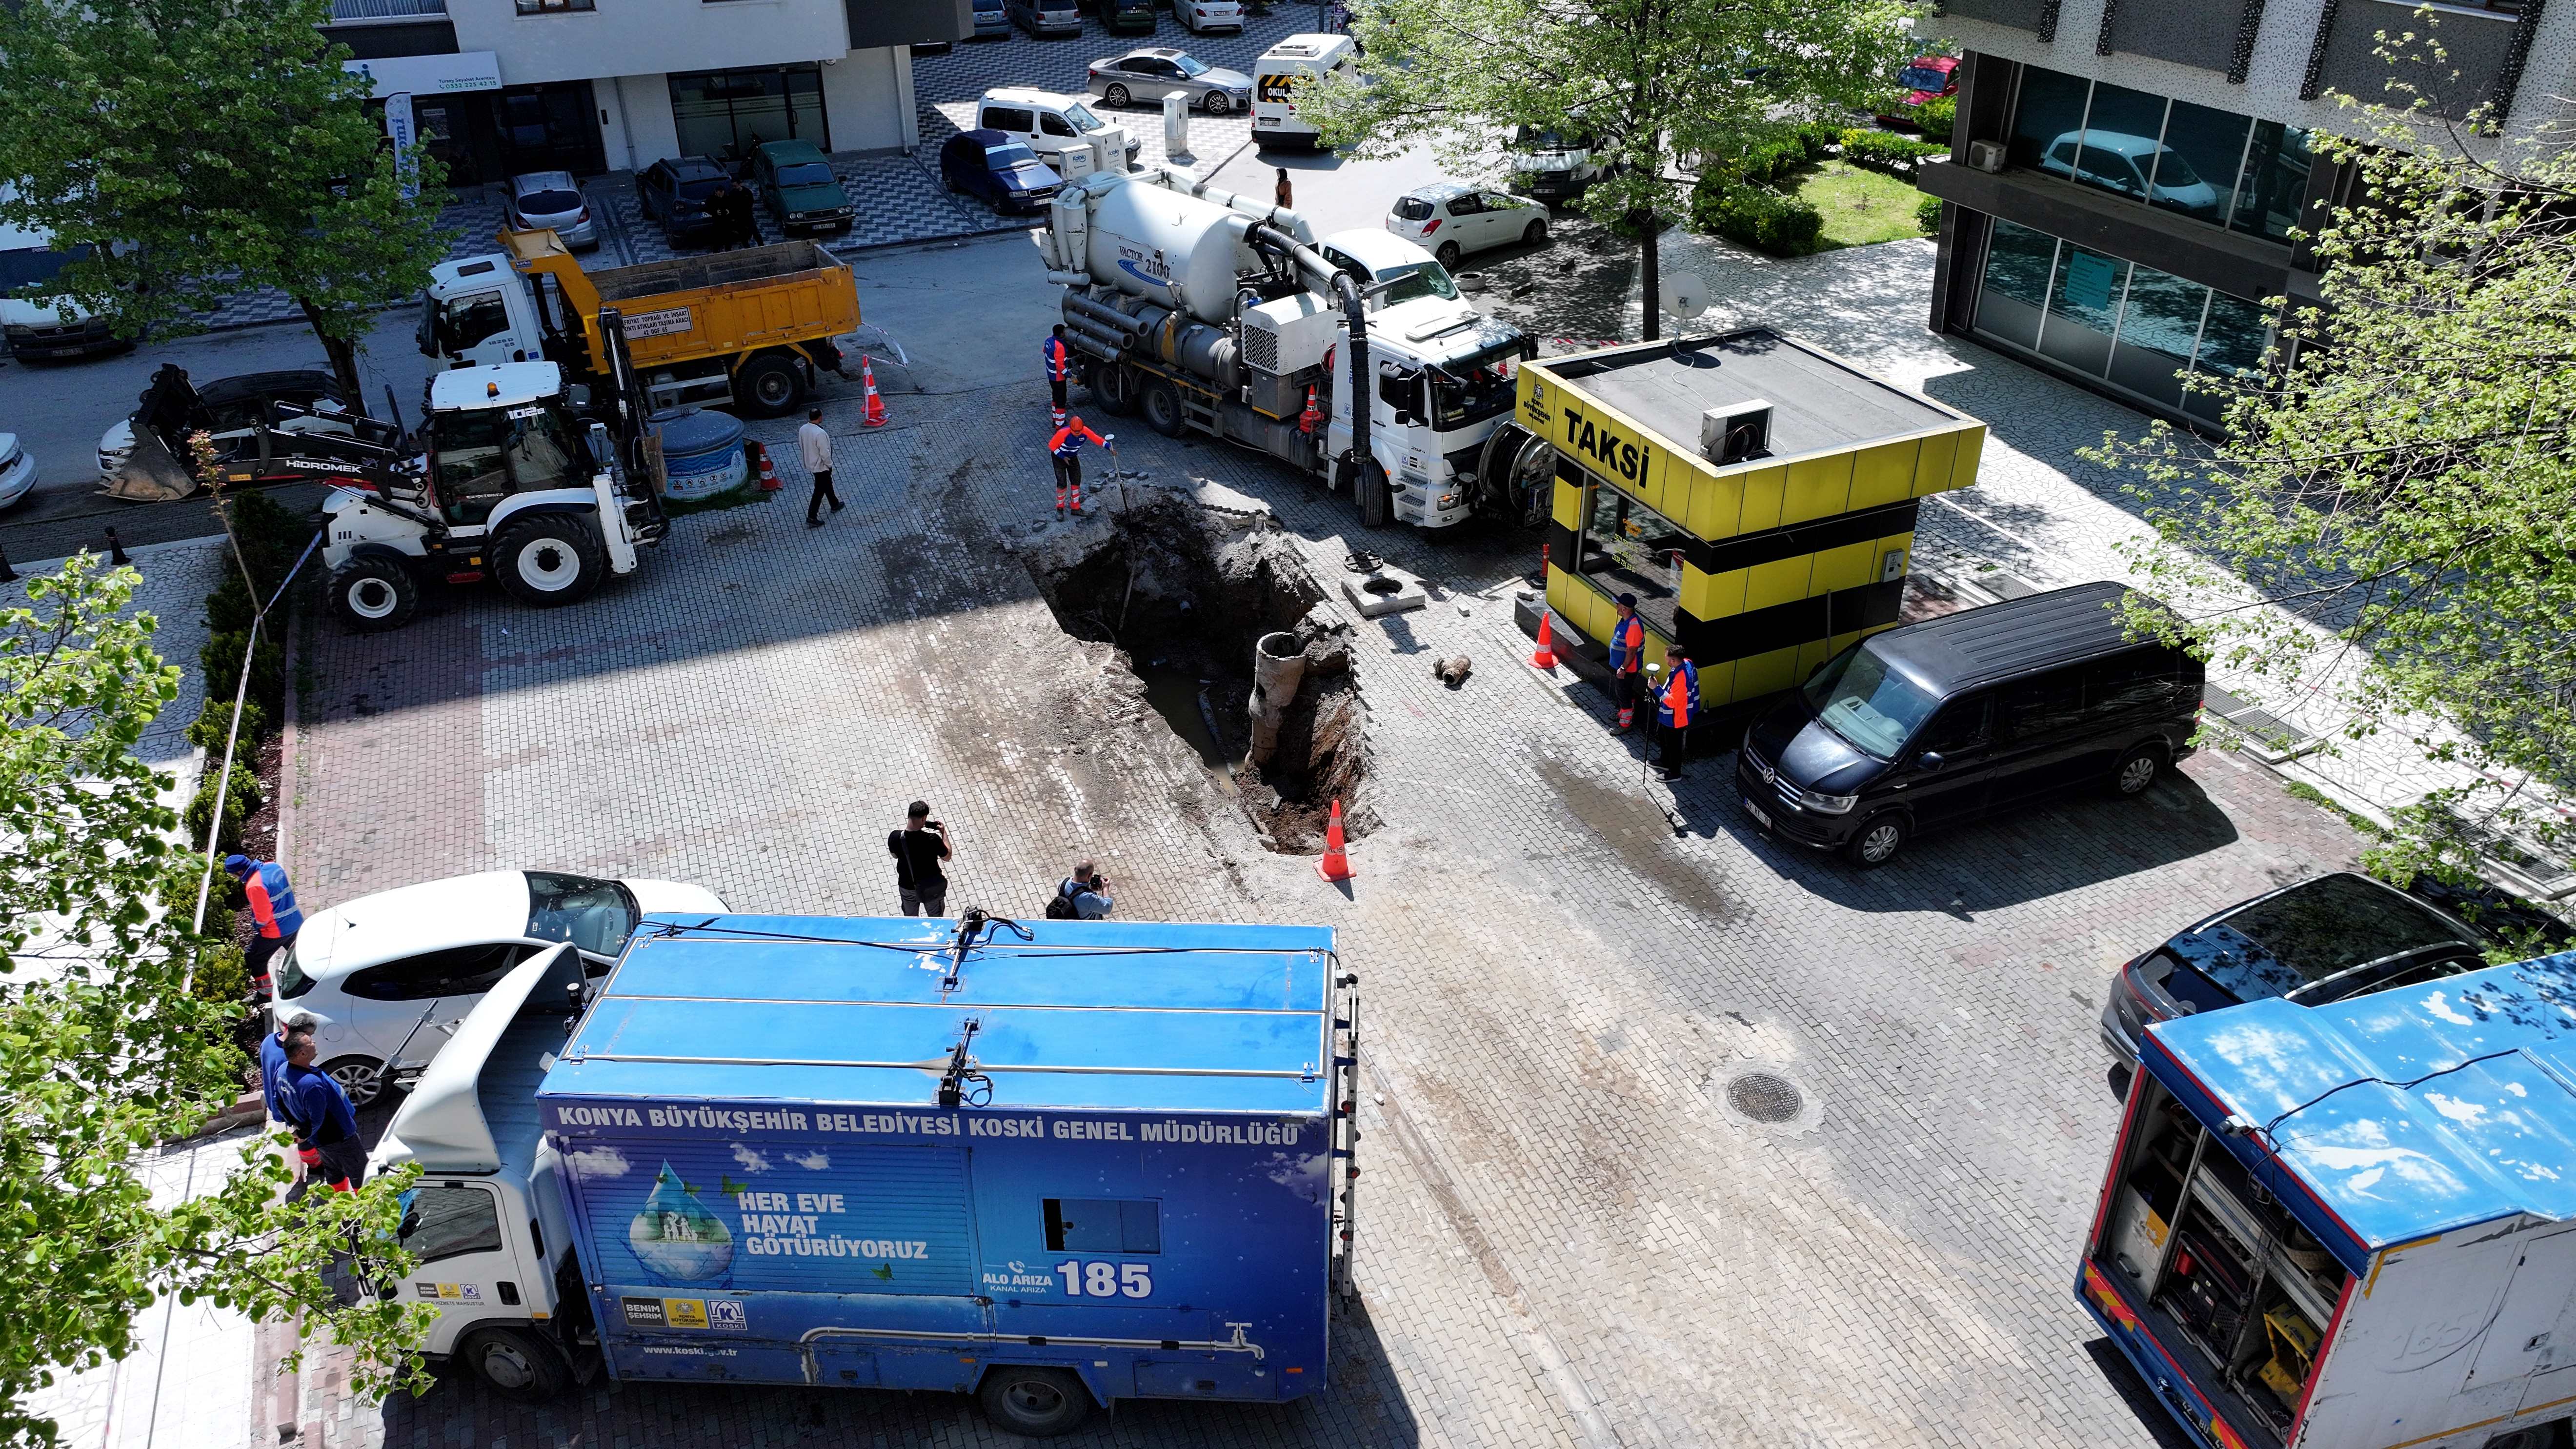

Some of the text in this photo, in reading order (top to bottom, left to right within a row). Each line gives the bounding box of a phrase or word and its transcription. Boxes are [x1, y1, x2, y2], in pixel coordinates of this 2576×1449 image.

[1268, 87, 1286, 97] OKUL
[1119, 245, 1143, 262] VACTOR
[1145, 259, 1171, 279] 2100
[637, 322, 657, 330] ATIKLARI
[659, 319, 675, 327] TAŞIMA
[642, 314, 661, 322] TOPRAĞI
[1565, 407, 1650, 489] TAKSİ
[1747, 799, 1752, 809] 42
[558, 1105, 1298, 1145] KONYA BÜYÜKŞEHİR BELEDİYESİ KOSKİ GENEL MÜDÜRLÜĞÜ
[738, 1192, 845, 1212] HER EVE
[742, 1214, 819, 1234] HAYAT
[746, 1233, 928, 1259] GÖTÜRÜYORUZ
[983, 1273, 1053, 1286] ALO ARIZA
[1057, 1261, 1151, 1298] 185
[719, 1308, 734, 1320] K
